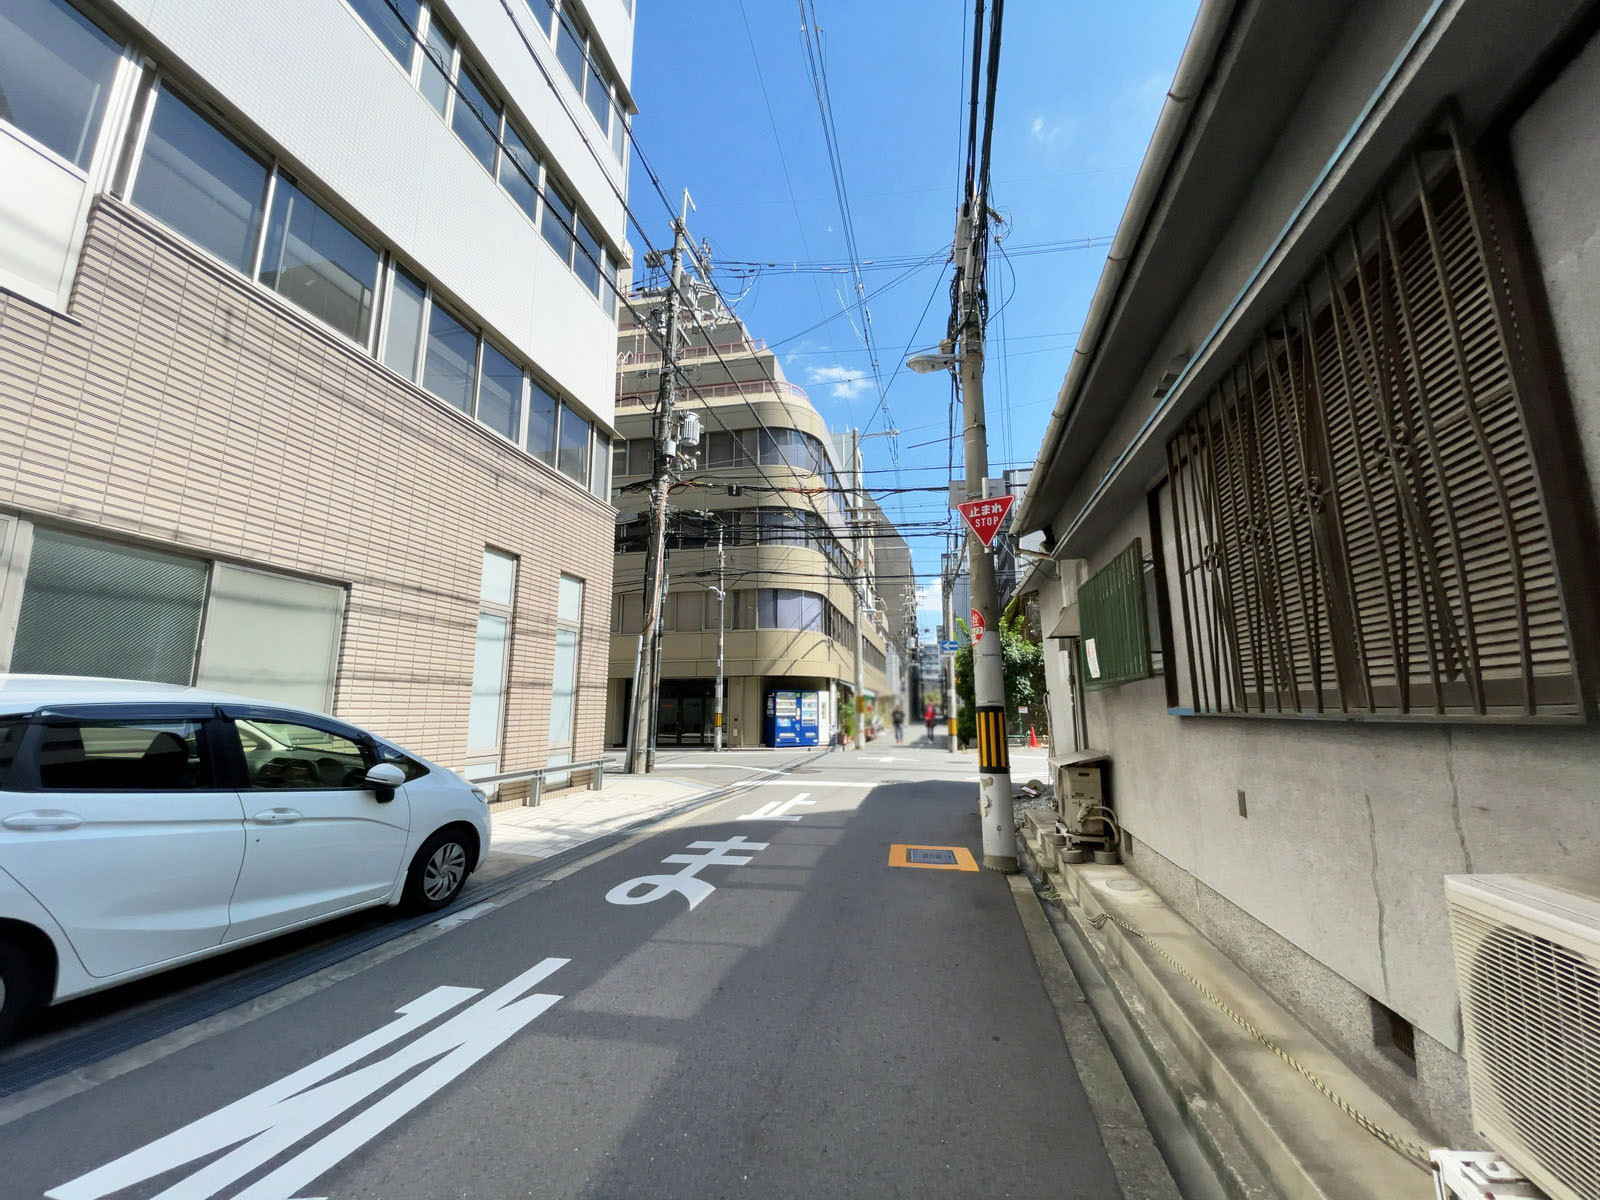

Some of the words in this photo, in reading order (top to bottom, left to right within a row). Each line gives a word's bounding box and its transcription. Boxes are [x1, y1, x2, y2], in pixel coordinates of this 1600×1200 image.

[969, 503, 1003, 517] 止まれ
[975, 516, 998, 527] STOP
